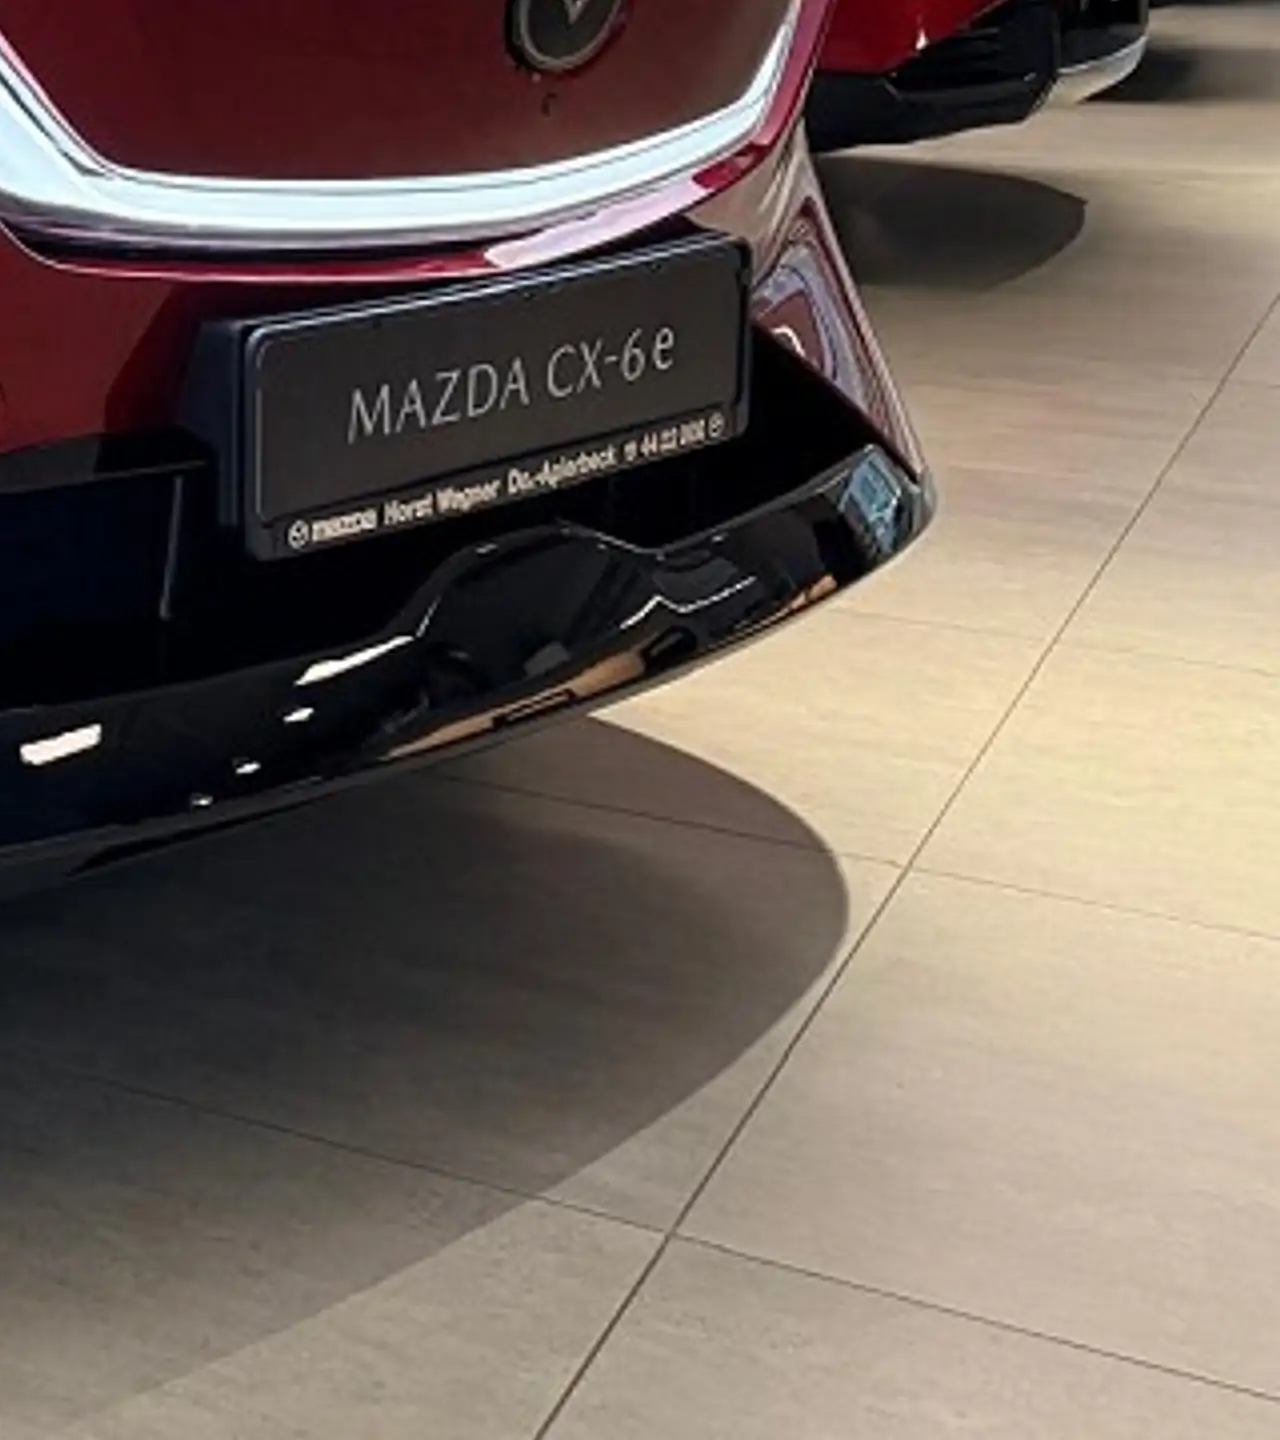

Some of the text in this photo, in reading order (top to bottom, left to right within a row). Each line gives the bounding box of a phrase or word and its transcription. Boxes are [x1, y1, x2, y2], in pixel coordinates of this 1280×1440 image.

[348, 326, 674, 445] MAZDA CX-6e
[383, 492, 433, 526] Horst
